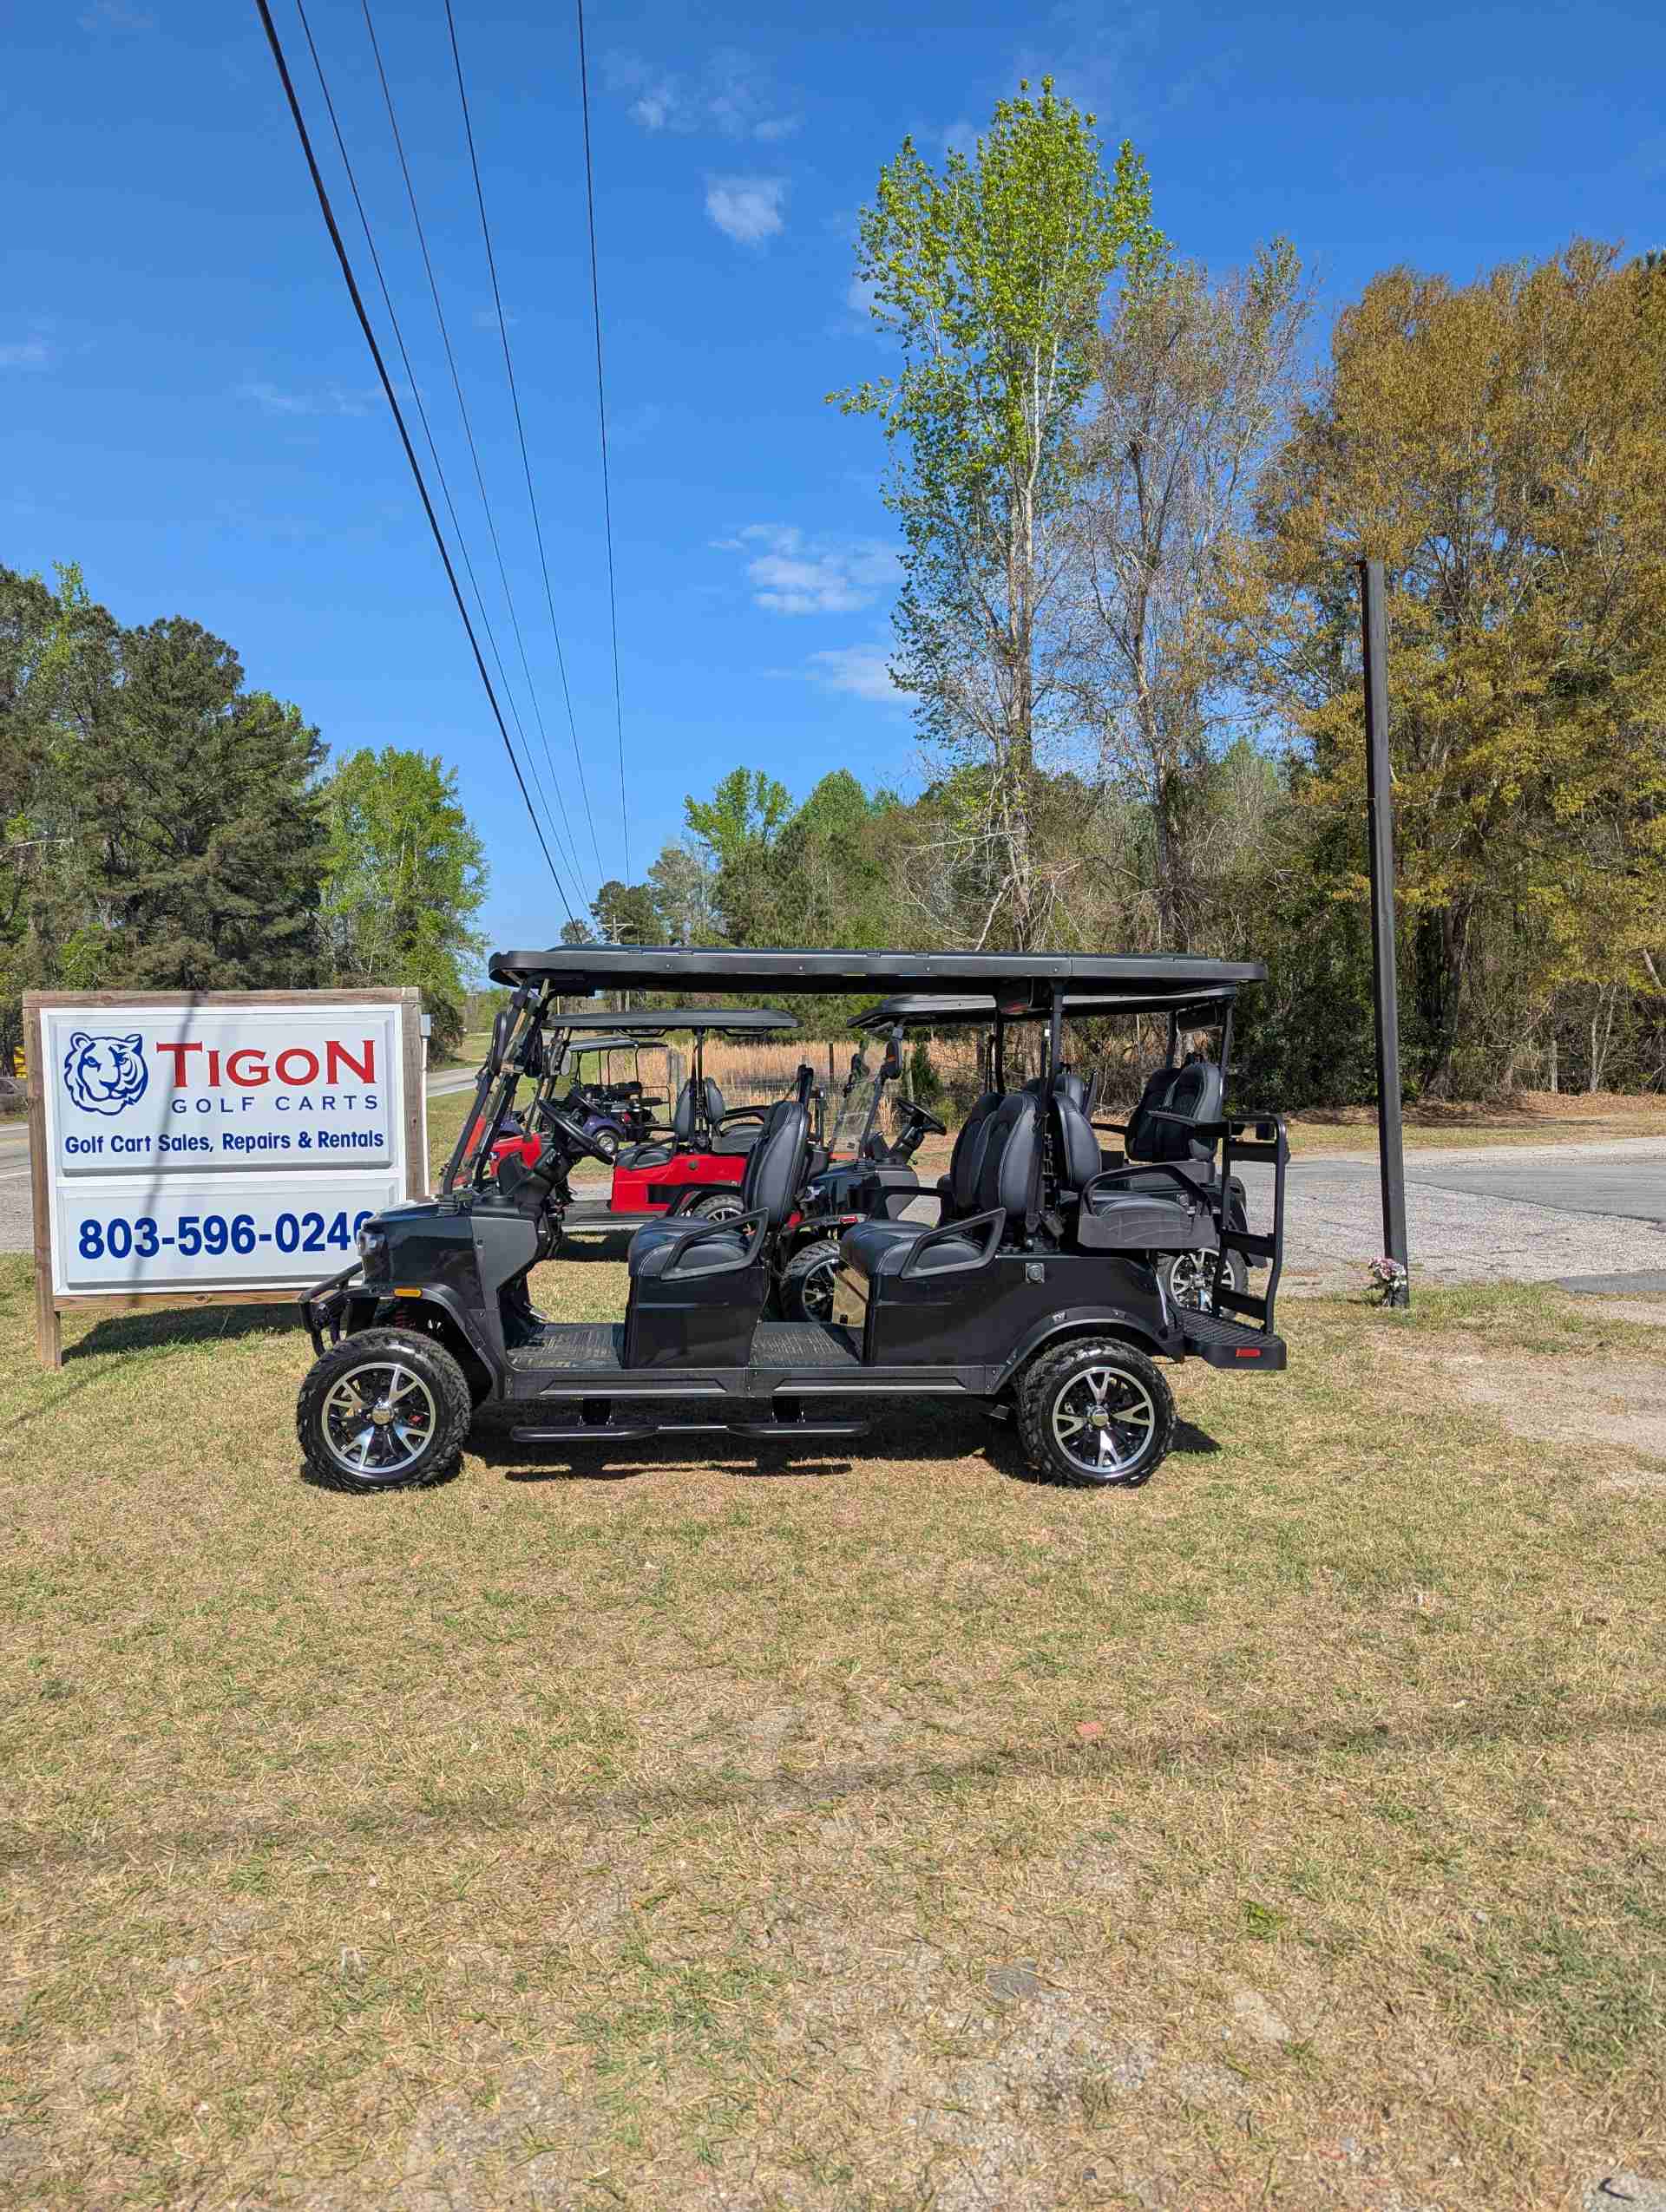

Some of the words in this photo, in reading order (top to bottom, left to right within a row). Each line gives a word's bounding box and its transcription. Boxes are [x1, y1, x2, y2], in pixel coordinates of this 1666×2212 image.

[171, 1096, 255, 1114] GOLF
[275, 1094, 379, 1111] CARTS
[64, 1135, 105, 1154] Golf
[110, 1135, 152, 1153] Cart
[158, 1133, 214, 1154] Sales,
[222, 1131, 292, 1154] Repairs
[298, 1130, 313, 1149] &
[318, 1129, 384, 1149] Rentals
